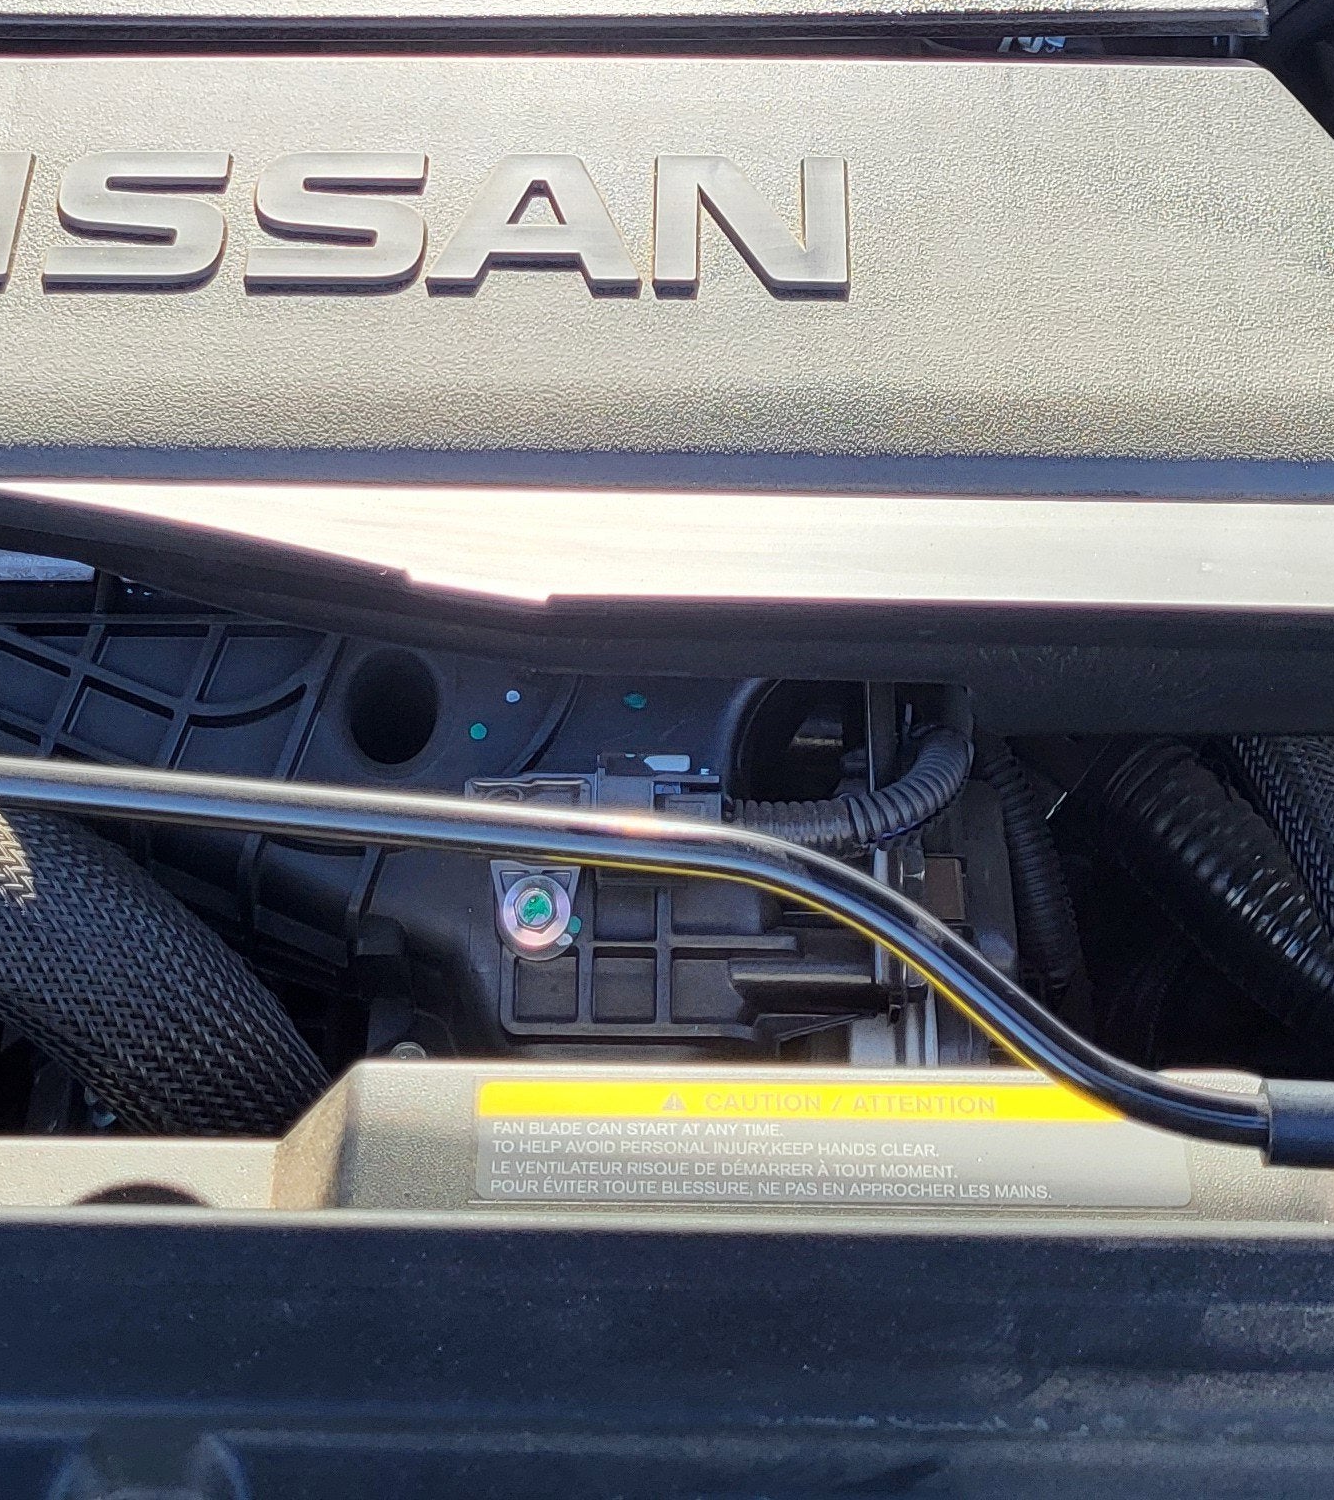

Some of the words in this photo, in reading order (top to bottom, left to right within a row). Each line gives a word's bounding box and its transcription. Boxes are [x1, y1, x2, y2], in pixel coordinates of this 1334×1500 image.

[704, 1092, 821, 1113] CAUTION
[852, 1094, 996, 1115] ATTENTION
[491, 1121, 525, 1135] FAN
[529, 1121, 582, 1135] BLADE
[586, 1121, 622, 1136] CAN
[626, 1122, 678, 1136] START
[681, 1123, 700, 1136] AT
[704, 1123, 738, 1137] ANY
[742, 1124, 784, 1137] TIME.
[491, 1140, 514, 1153] TO
[519, 1140, 562, 1153] HELP
[565, 1140, 616, 1154] AVOID
[620, 1141, 711, 1155] PERSONAL
[818, 1142, 876, 1156] HANDS
[880, 1143, 940, 1157] CLEAR.
[491, 1161, 511, 1174] LE
[515, 1160, 623, 1175] VENTILATEUR
[627, 1161, 690, 1176] RISQUE
[694, 1162, 717, 1176] DE
[721, 1159, 814, 1177] DÉMARRER
[817, 1159, 830, 1177] À
[833, 1164, 877, 1178] TOUT
[880, 1164, 959, 1179] MOMENT.
[490, 1180, 538, 1193] POUR
[543, 1176, 599, 1194] ÉVITER
[603, 1181, 656, 1194] TOUTE
[661, 1181, 754, 1197] BLESSURE,
[758, 1182, 781, 1195] NE
[785, 1182, 818, 1196] PAS
[822, 1183, 845, 1196] EN
[849, 1183, 955, 1197] APPROCHER
[959, 1185, 990, 1198] LES
[994, 1185, 1053, 1199] MAINS.
